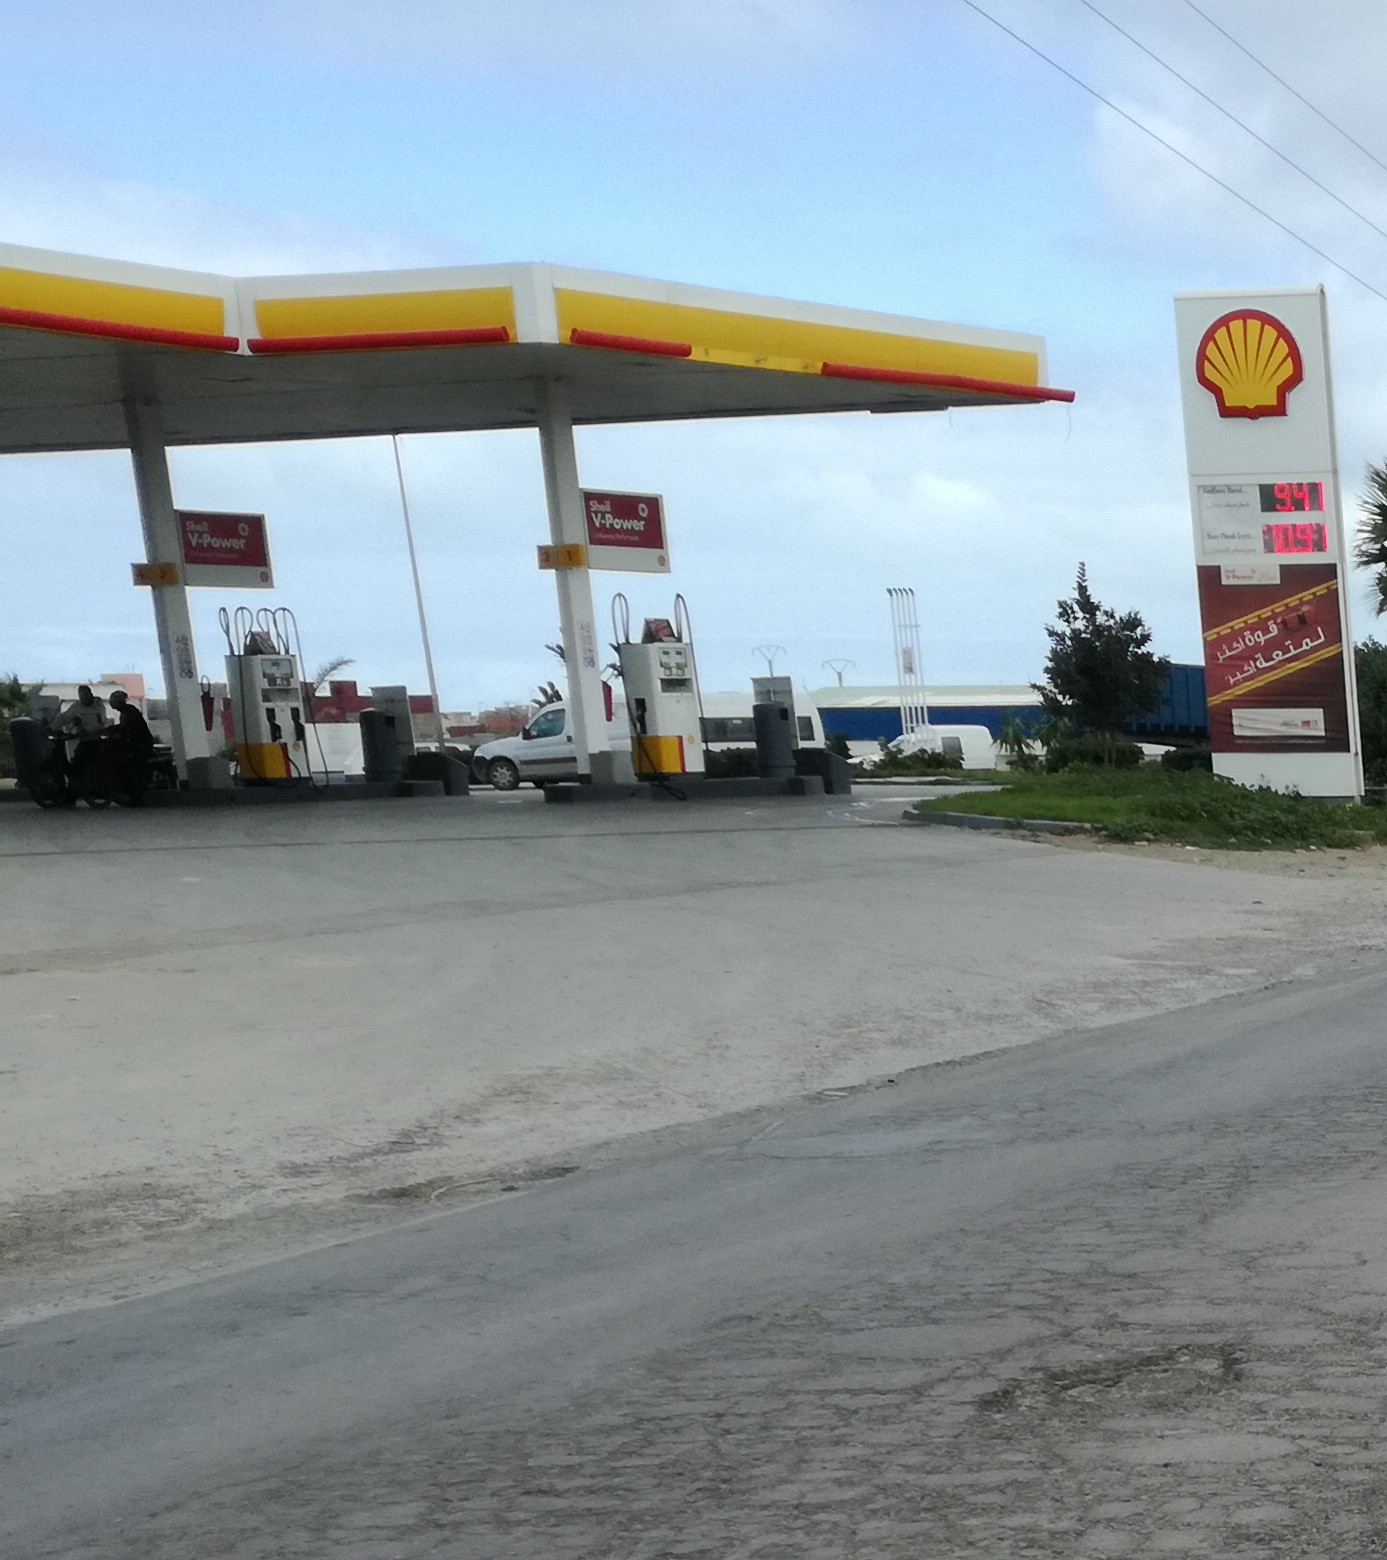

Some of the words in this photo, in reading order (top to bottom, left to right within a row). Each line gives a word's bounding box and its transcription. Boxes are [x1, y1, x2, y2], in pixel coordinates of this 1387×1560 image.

[589, 500, 611, 512] Shell
[186, 520, 209, 532] Shell
[591, 512, 645, 531] V-Power
[187, 532, 246, 549] V-Power
